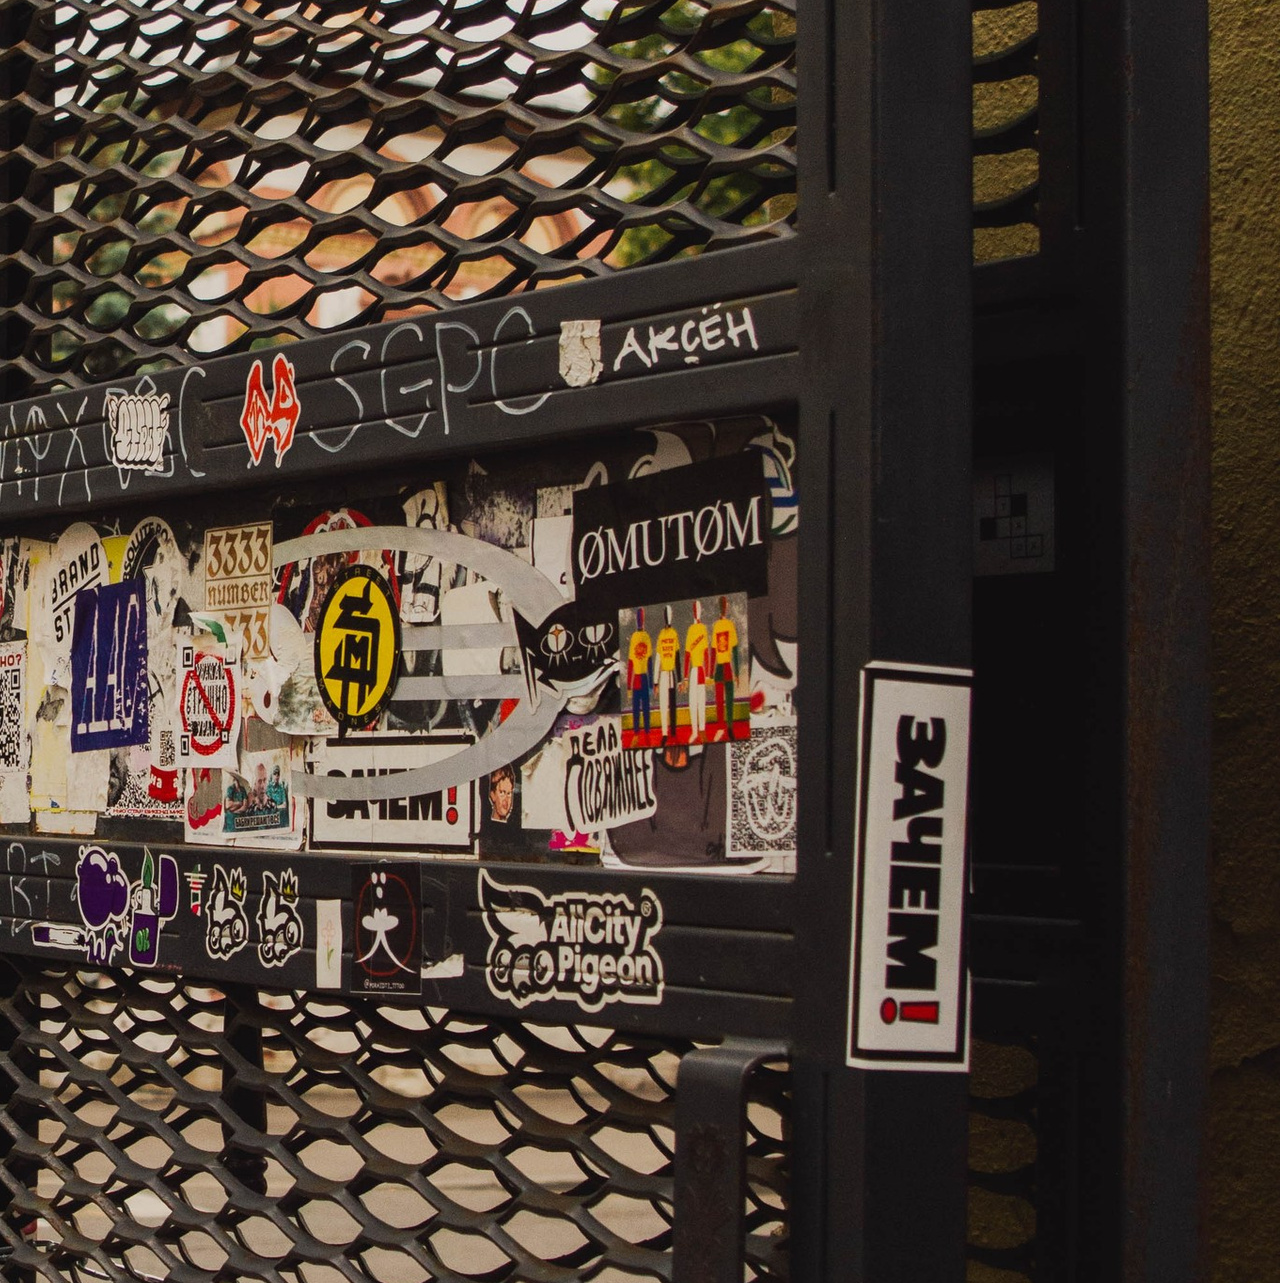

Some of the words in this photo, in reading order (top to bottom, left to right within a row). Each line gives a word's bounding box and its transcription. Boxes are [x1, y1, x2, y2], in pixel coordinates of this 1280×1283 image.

[207, 527, 270, 578] 3333
[880, 714, 947, 1025] ЗАЧЕМ!
[557, 945, 653, 994] Pigeon
